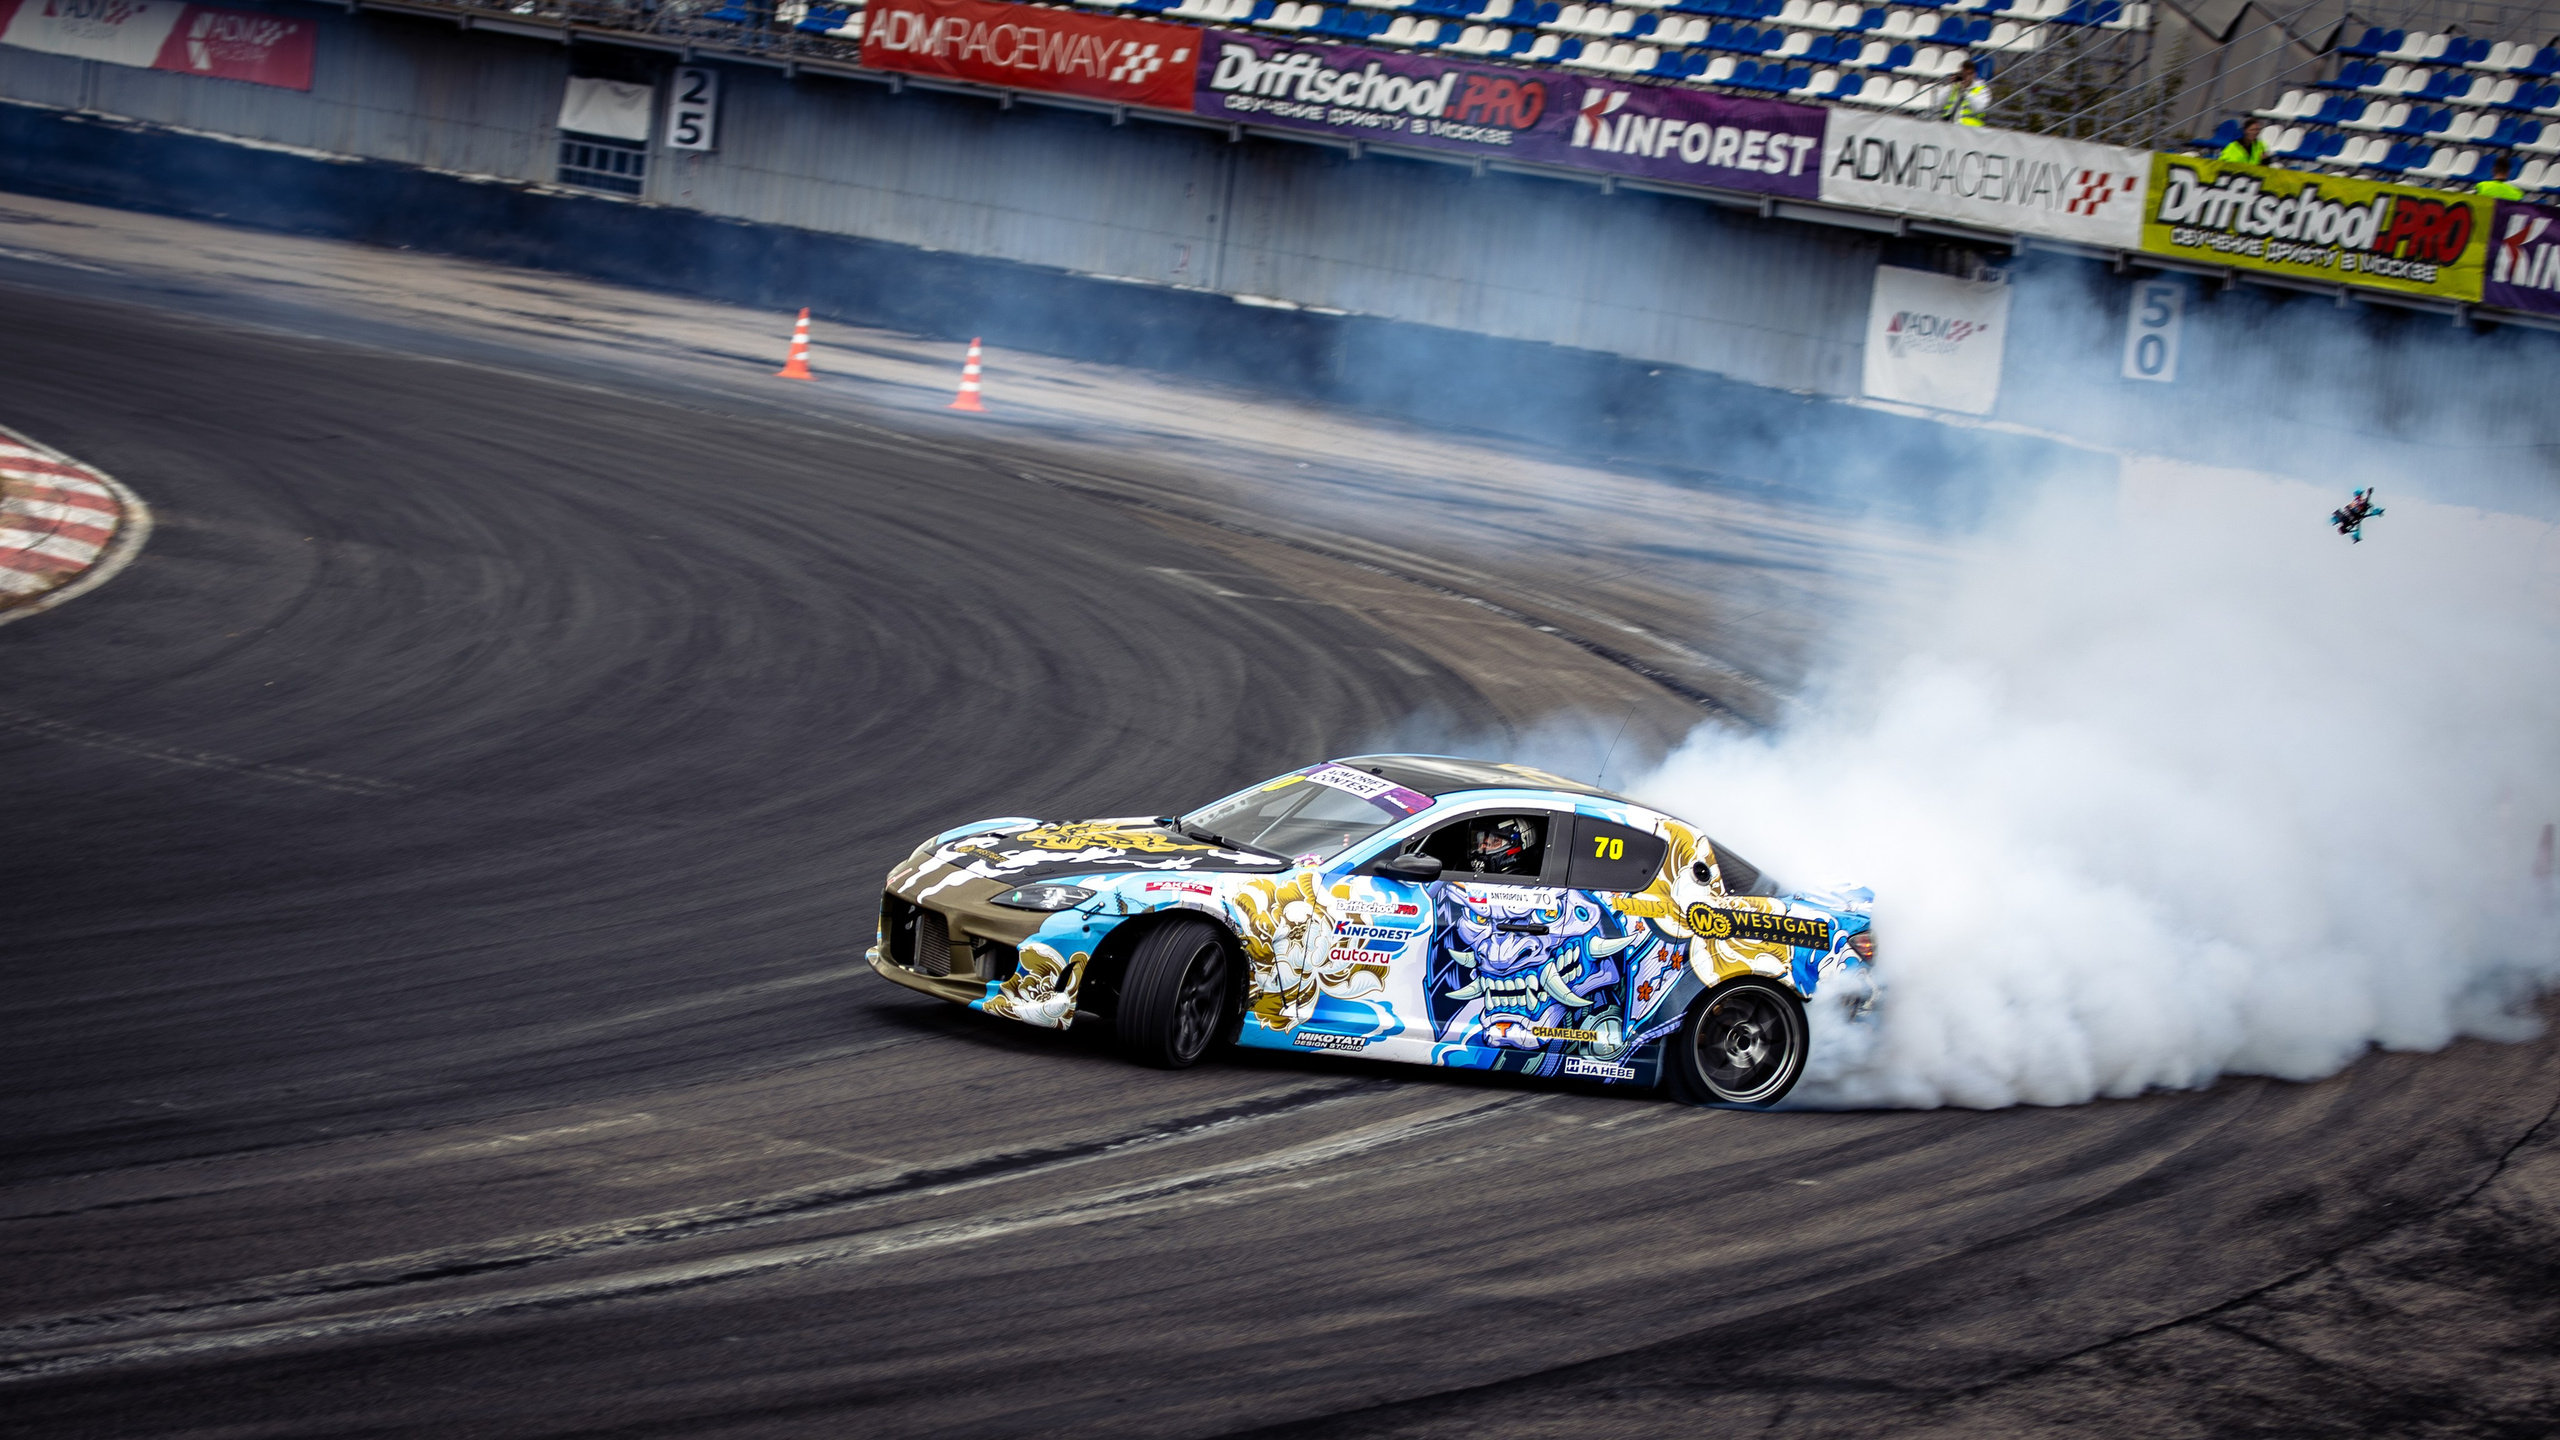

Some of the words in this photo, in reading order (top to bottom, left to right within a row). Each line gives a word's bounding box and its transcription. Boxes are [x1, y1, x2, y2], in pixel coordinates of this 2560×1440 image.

[864, 8, 1122, 79] ADMRACEWAY
[1224, 94, 1325, 121] ОБУЧЕНИЕ
[1327, 108, 1407, 131] ДРИФТУ
[1410, 119, 1427, 135] В
[1430, 121, 1513, 145] МОСКВЕ
[1570, 87, 1817, 177] KINFOREST
[1831, 134, 2079, 211] ADMRACEWAY
[2171, 228, 2264, 258] ОБУЧЕНИЕ
[2265, 241, 2340, 268] ДРИФТУ
[2340, 253, 2357, 271] В
[2359, 256, 2439, 283] МОСКВЕ
[1313, 774, 1377, 794] CONTEST
[1594, 836, 1624, 860] 70
[1533, 893, 1551, 905] 70
[1334, 921, 1412, 940] KINFOREST
[1732, 911, 1828, 937] WESTGATE
[1735, 931, 1829, 949] AUTOSERVICE
[1330, 949, 1390, 964] auto.ru
[1297, 1032, 1366, 1046] MIKOTATI
[1531, 1026, 1598, 1041] CHAMELEON
[1293, 1040, 1327, 1048] DESIGN
[1329, 1043, 1363, 1051] STUDIO
[1581, 1064, 1599, 1075] НА
[1600, 1066, 1634, 1078] НЕВЕ
